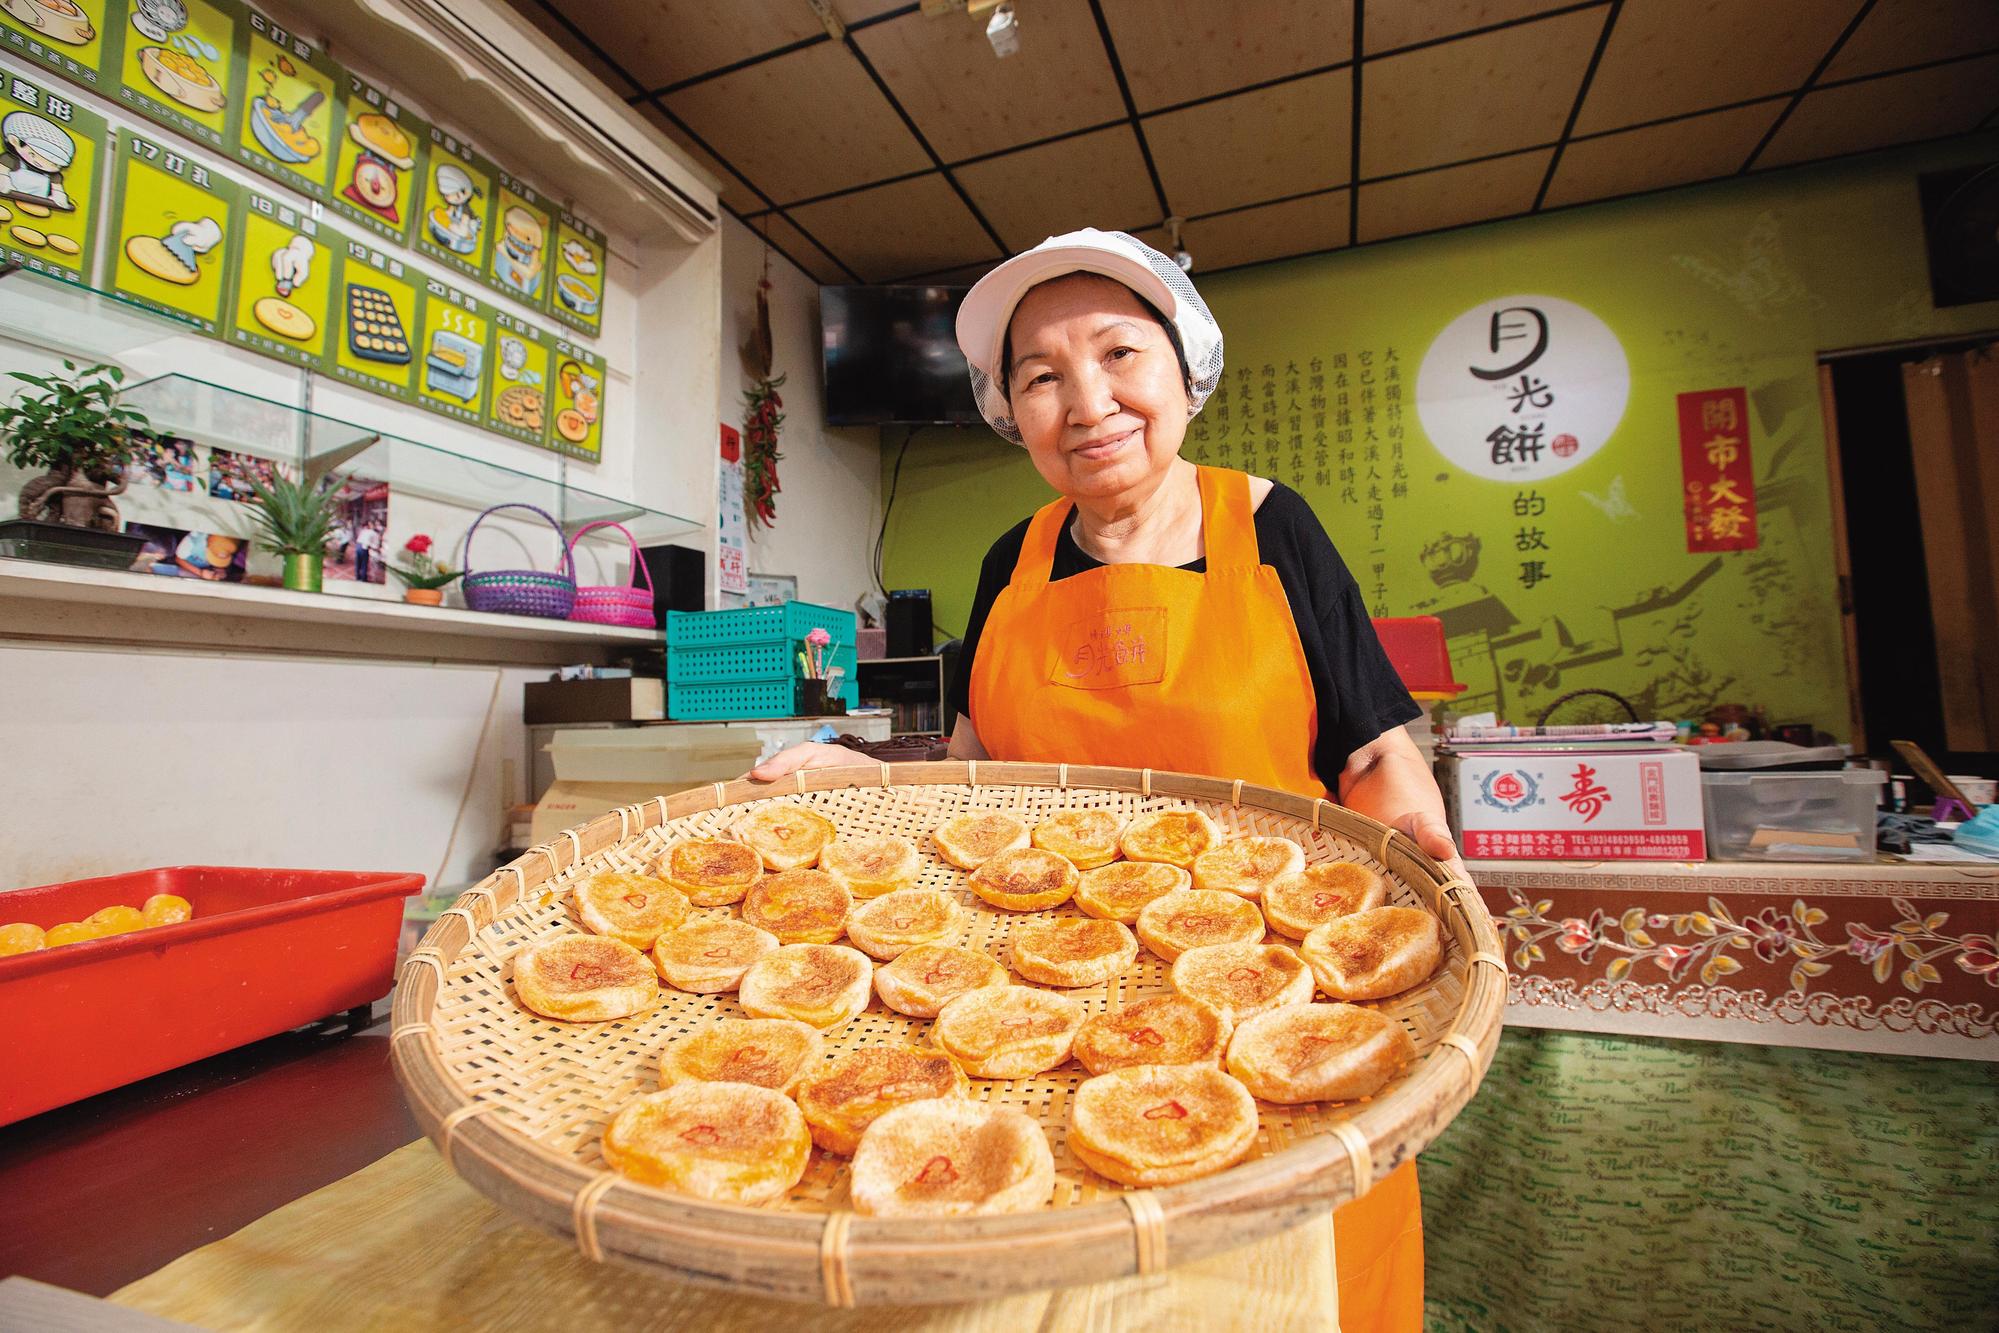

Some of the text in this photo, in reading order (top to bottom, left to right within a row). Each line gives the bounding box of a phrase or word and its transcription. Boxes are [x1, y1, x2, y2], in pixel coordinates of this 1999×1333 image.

[131, 139, 212, 189] 17打孔
[1262, 363, 1281, 480] 而當時麵粉有
[1286, 359, 1307, 497] 大溪人習慣在中
[1309, 356, 1331, 487] 台灣物資受管制
[1469, 306, 1555, 465] 月光餅
[1513, 489, 1552, 590] 的故事
[1558, 763, 1613, 824] 壽
